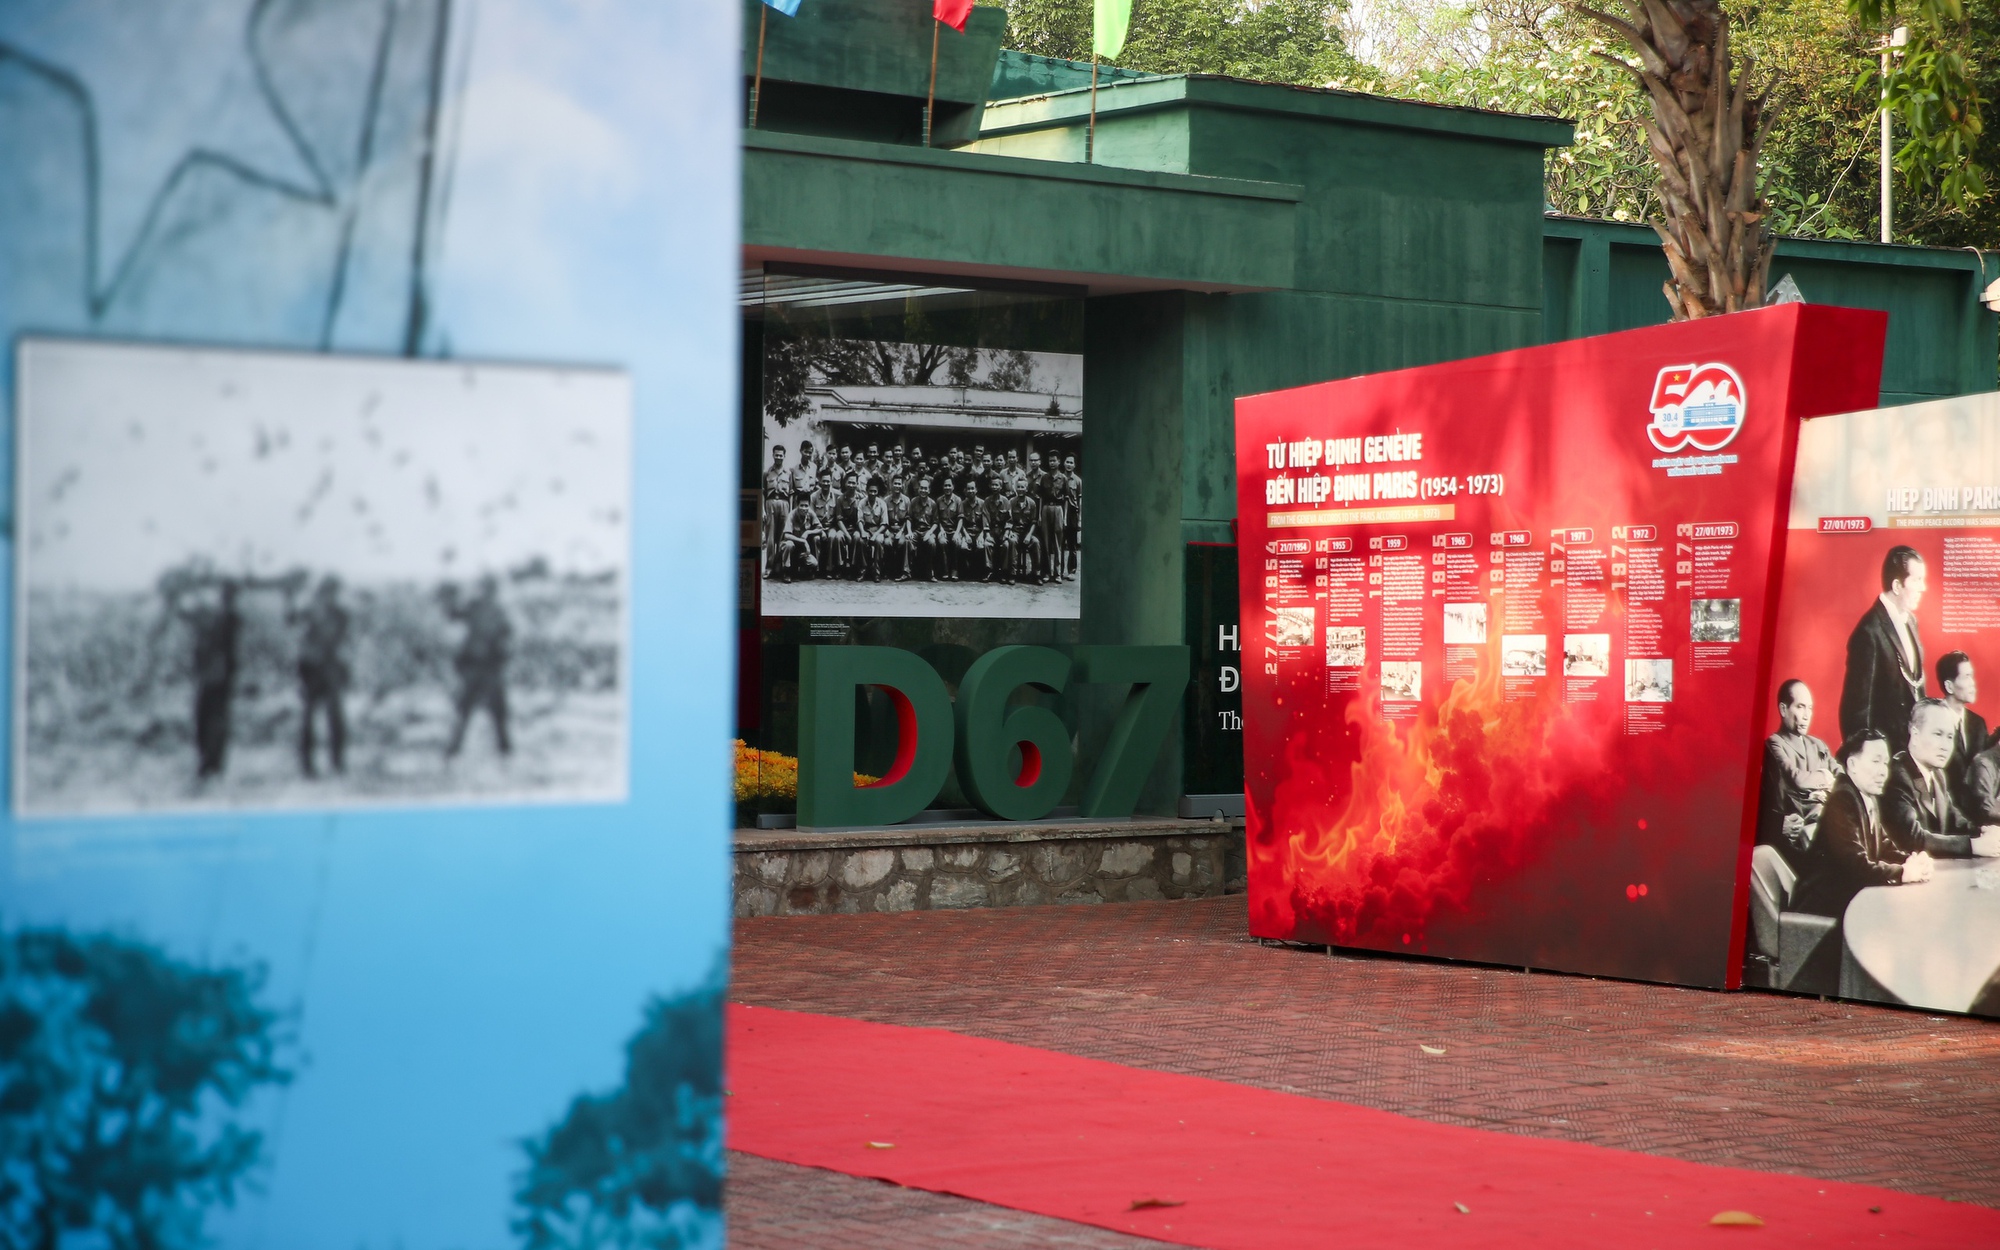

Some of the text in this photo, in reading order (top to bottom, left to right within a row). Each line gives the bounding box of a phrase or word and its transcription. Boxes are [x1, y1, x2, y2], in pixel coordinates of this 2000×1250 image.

[1266, 427, 1422, 473] TỪ HIỆP ĐỊNH GENÈVE
[1265, 472, 1294, 505] ĐẾN
[1298, 472, 1331, 509] HIỆP
[1333, 473, 1370, 507] ĐỊNH
[1373, 470, 1417, 500] PARIS
[1420, 477, 1457, 500] (1954
[1466, 473, 1504, 497] 1973)
[1823, 520, 1865, 530] 27/01/1973
[1570, 531, 1586, 541] 1971
[1632, 529, 1649, 539] 1972
[1695, 526, 1733, 537] 27/01/1973
[1387, 538, 1401, 548] 1959
[1451, 536, 1466, 546] 1965
[1509, 534, 1525, 544] 1968
[1280, 542, 1307, 552] 21/7/1954
[1332, 541, 1346, 550] 1955
[1218, 710, 1244, 730] Th
[796, 644, 1191, 832] D67
